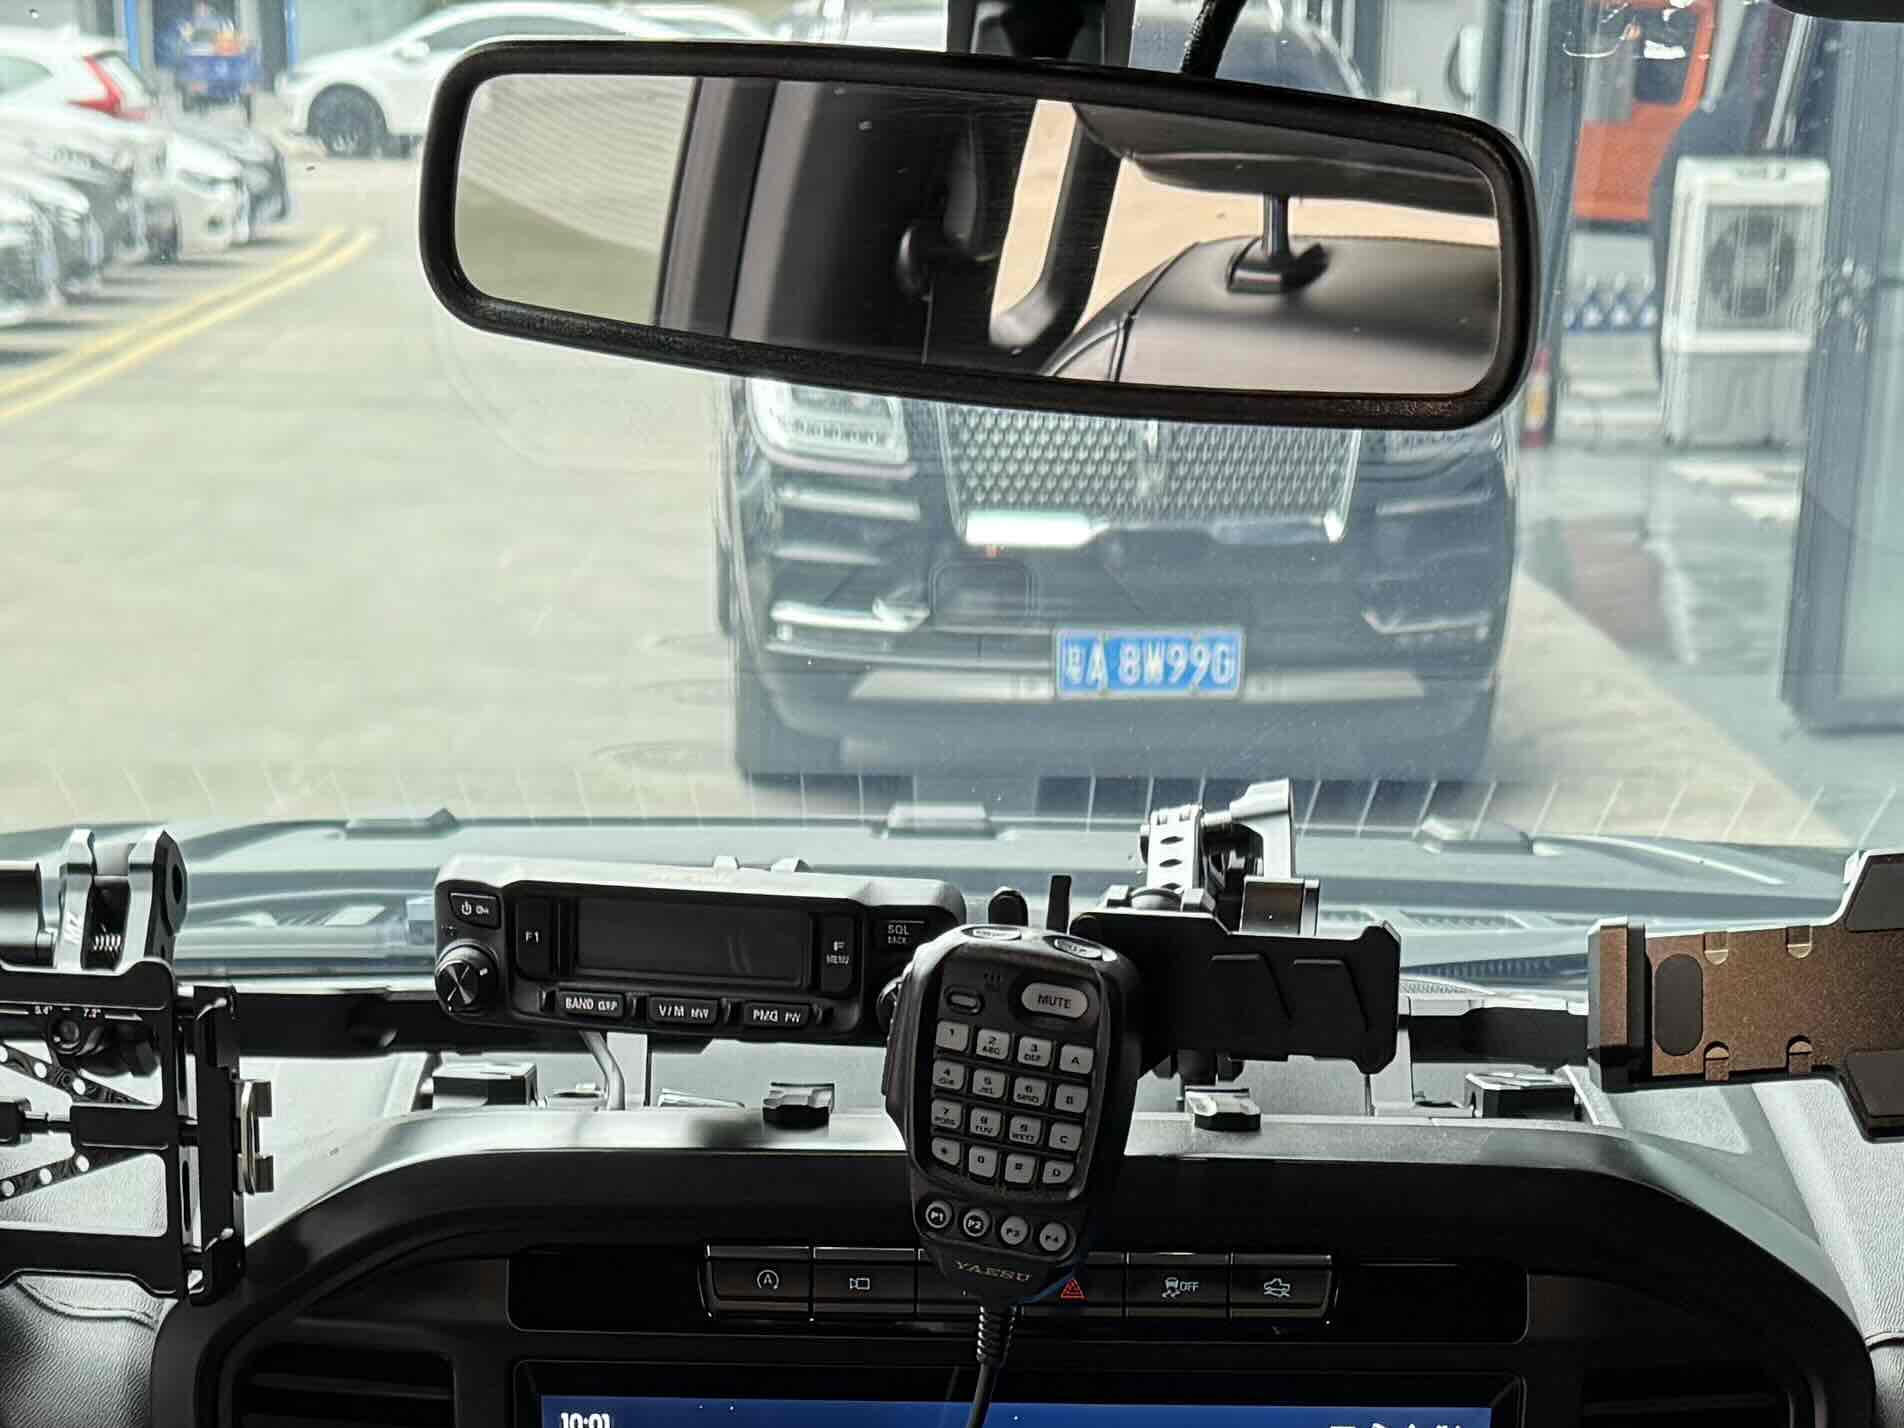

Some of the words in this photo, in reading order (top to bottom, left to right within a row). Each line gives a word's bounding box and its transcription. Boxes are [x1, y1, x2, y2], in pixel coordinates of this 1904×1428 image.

[887, 924, 910, 936] SQL
[525, 931, 540, 943] F1
[833, 941, 845, 951] F
[826, 955, 849, 965] MENU
[565, 997, 594, 1011] BAND
[1038, 994, 1072, 1009] MUTE
[659, 1004, 685, 1018] V/M
[1071, 1056, 1080, 1065] A
[1059, 1135, 1069, 1144] C
[930, 1210, 944, 1222] P1
[967, 1218, 982, 1230] P2
[954, 1260, 1033, 1282] YAESU
[1180, 1281, 1200, 1293] OFF
